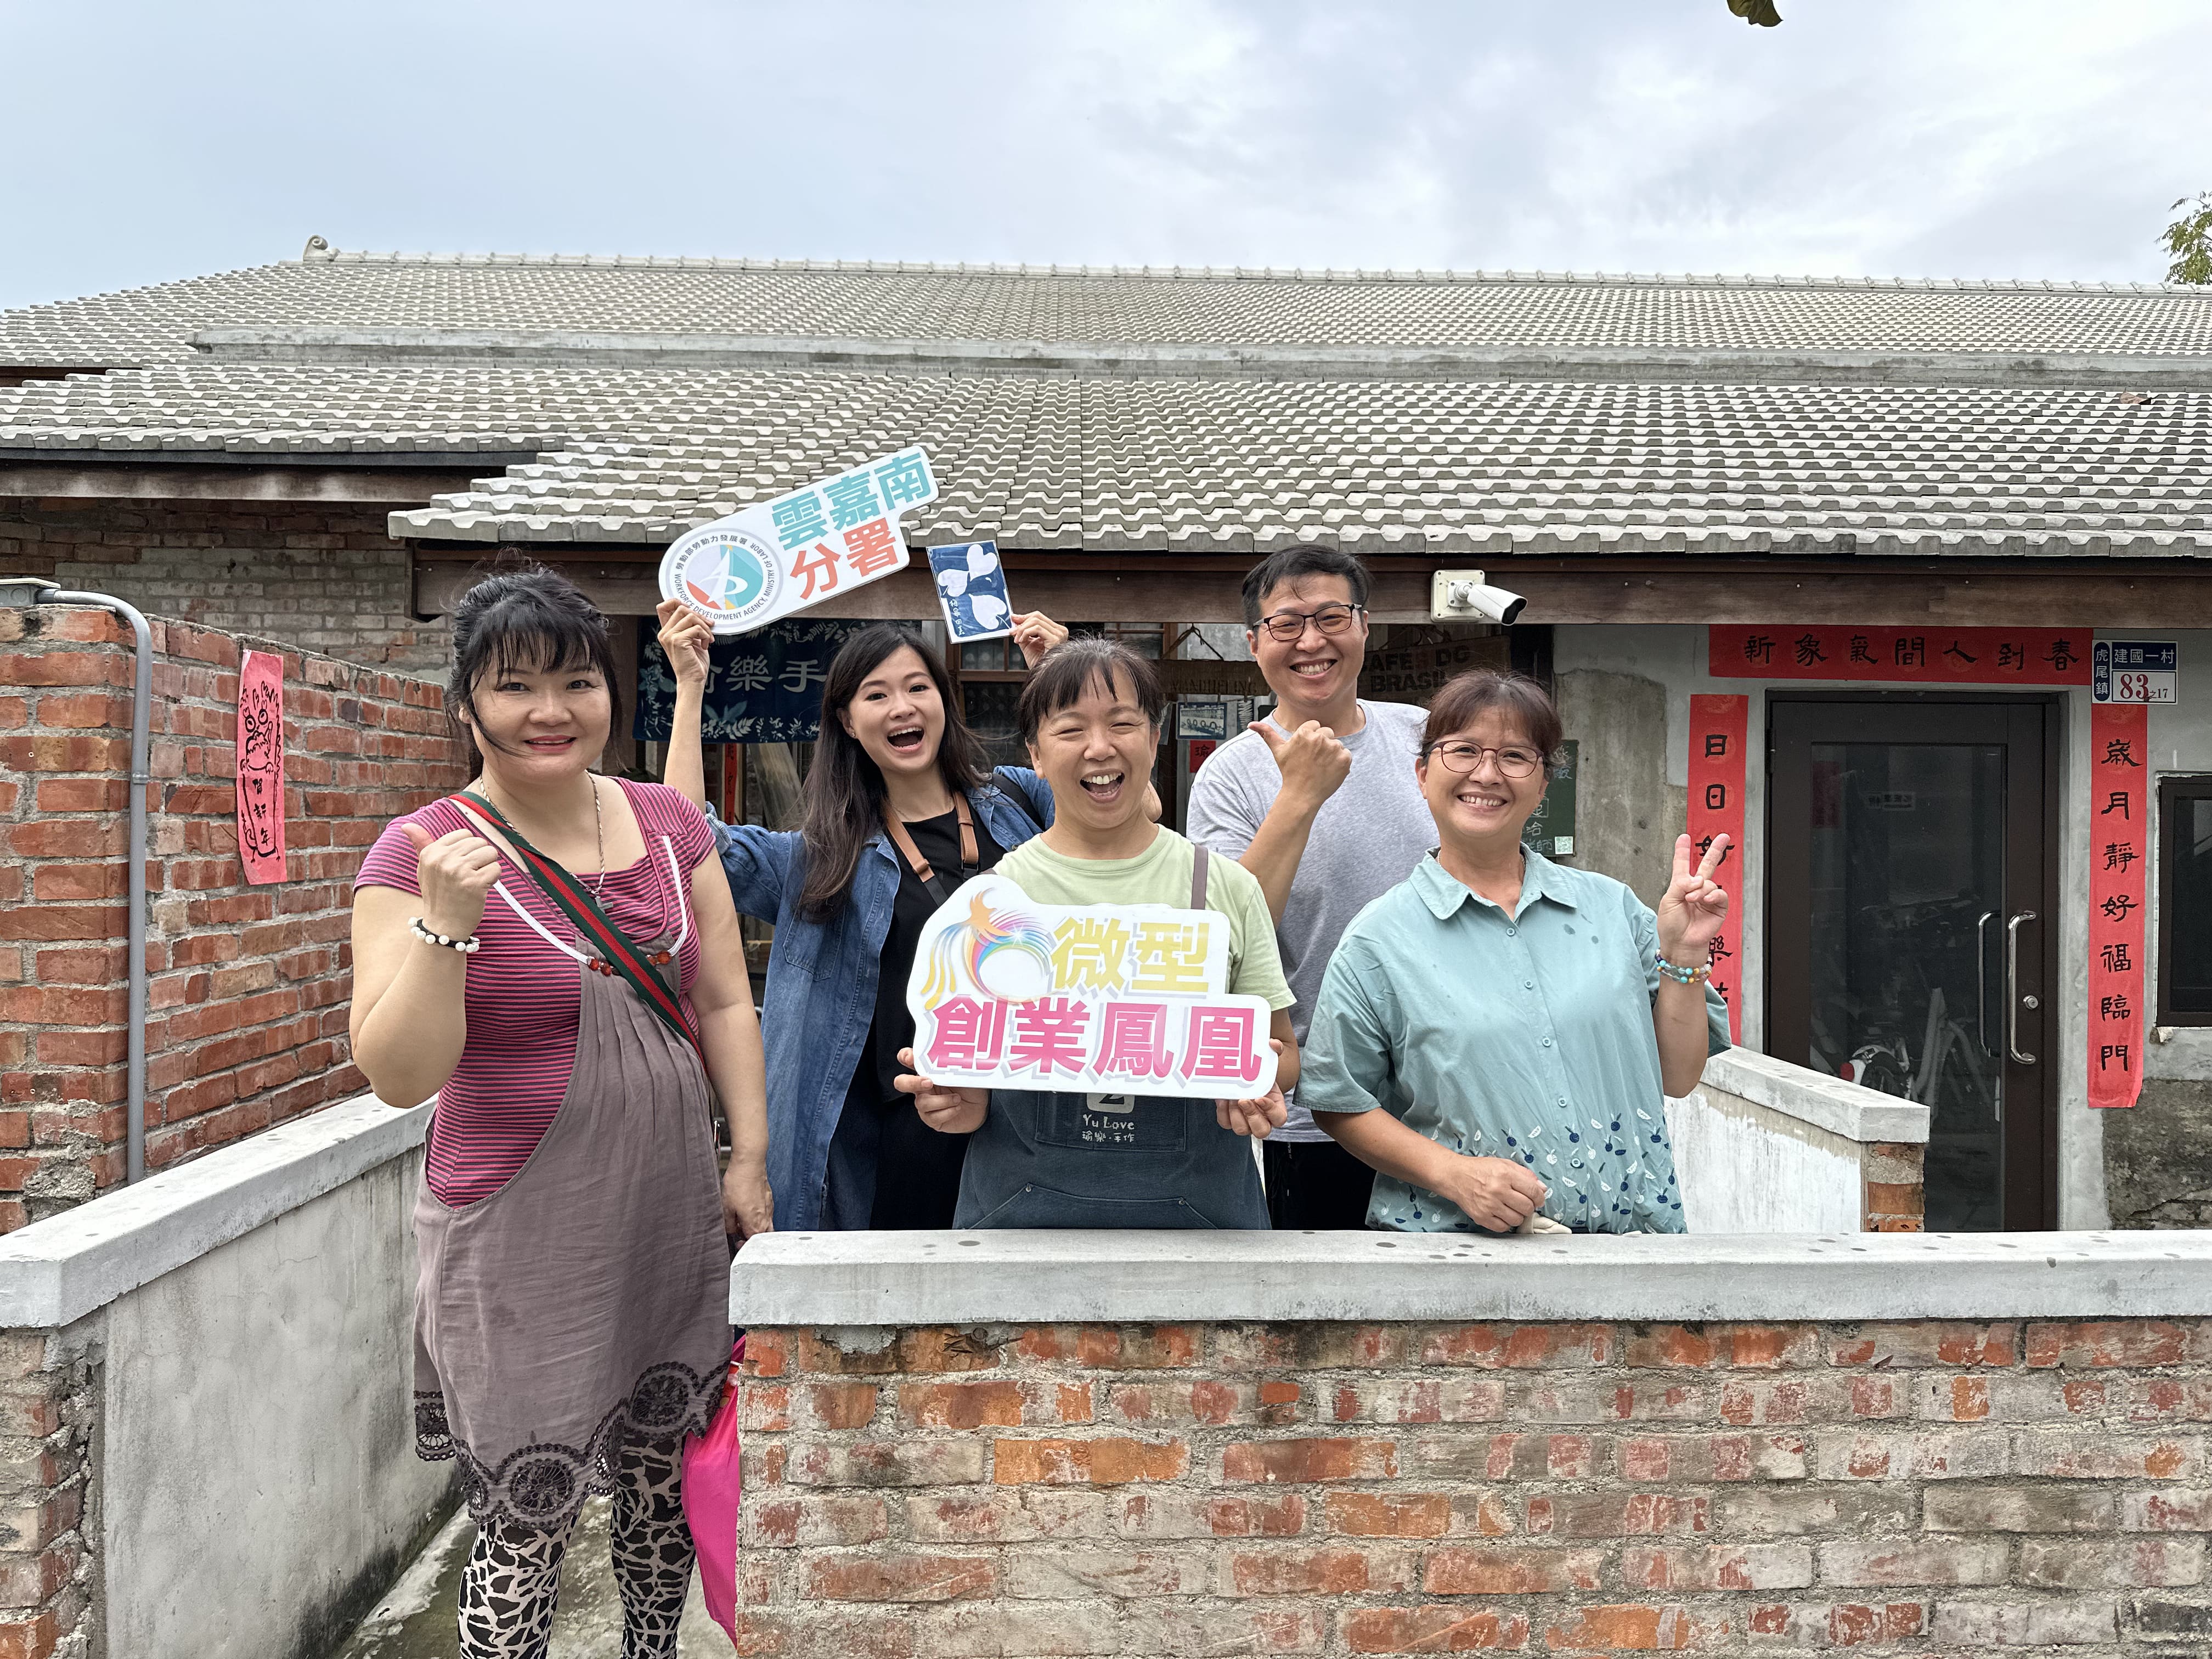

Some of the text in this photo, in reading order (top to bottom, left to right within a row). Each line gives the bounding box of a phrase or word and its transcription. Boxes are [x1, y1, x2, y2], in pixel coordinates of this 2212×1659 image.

[772, 453, 931, 550] 雲嘉南
[675, 534, 748, 570] 勞動部勞動力發展署
[750, 543, 768, 559] LABOR
[764, 560, 772, 568] OF
[789, 517, 898, 600] 分署
[674, 573, 695, 608] WORKFORCE
[764, 569, 775, 597] MINISTRY
[693, 606, 742, 620] DEVELOPMENT
[1362, 649, 1413, 672] AFÉ
[2095, 649, 2108, 695] 虎尾鎮
[2114, 648, 2174, 664] 建國一村
[1195, 744, 1212, 758] 瑜
[252, 778, 271, 846] 賀新年
[2100, 738, 2143, 1071] 歲月靜好福臨門
[1049, 916, 1210, 992] 微型
[927, 997, 1262, 1081] 創業鳳凰
[1082, 1114, 1135, 1130] Yu Love
